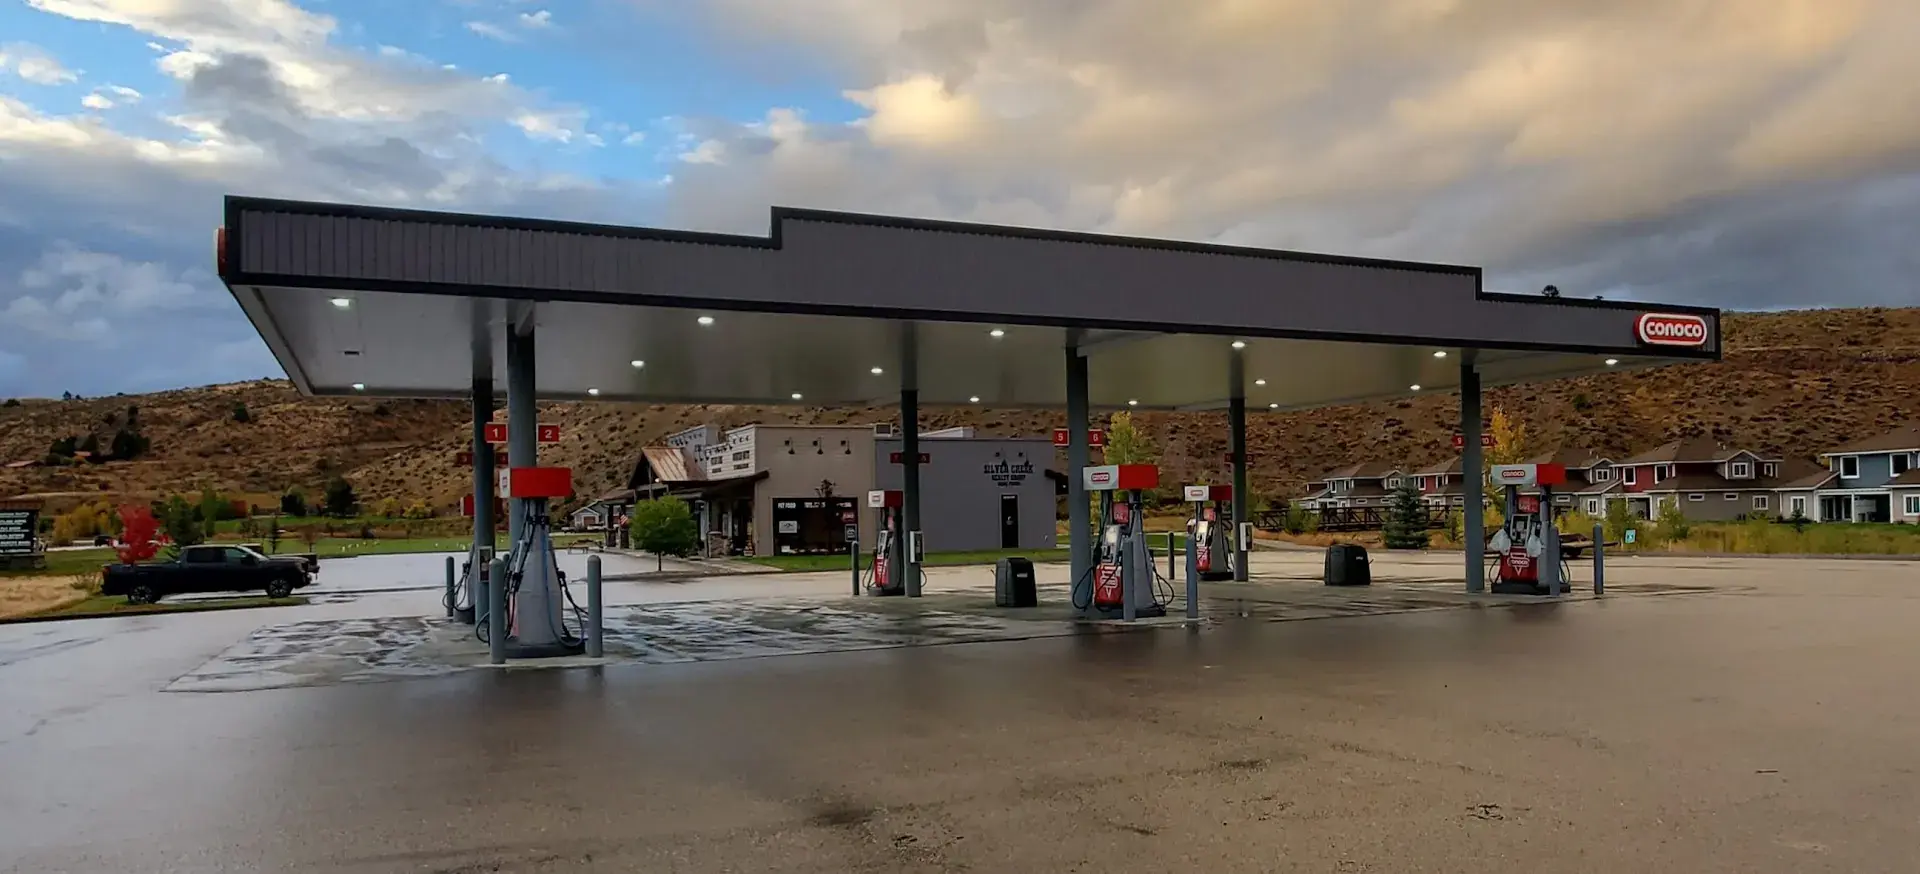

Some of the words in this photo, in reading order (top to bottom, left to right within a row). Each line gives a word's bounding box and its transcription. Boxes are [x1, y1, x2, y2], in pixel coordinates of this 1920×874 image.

[492, 428, 498, 438] 1
[545, 429, 552, 439] 2
[1057, 432, 1064, 441] 5
[1093, 433, 1099, 442] 6
